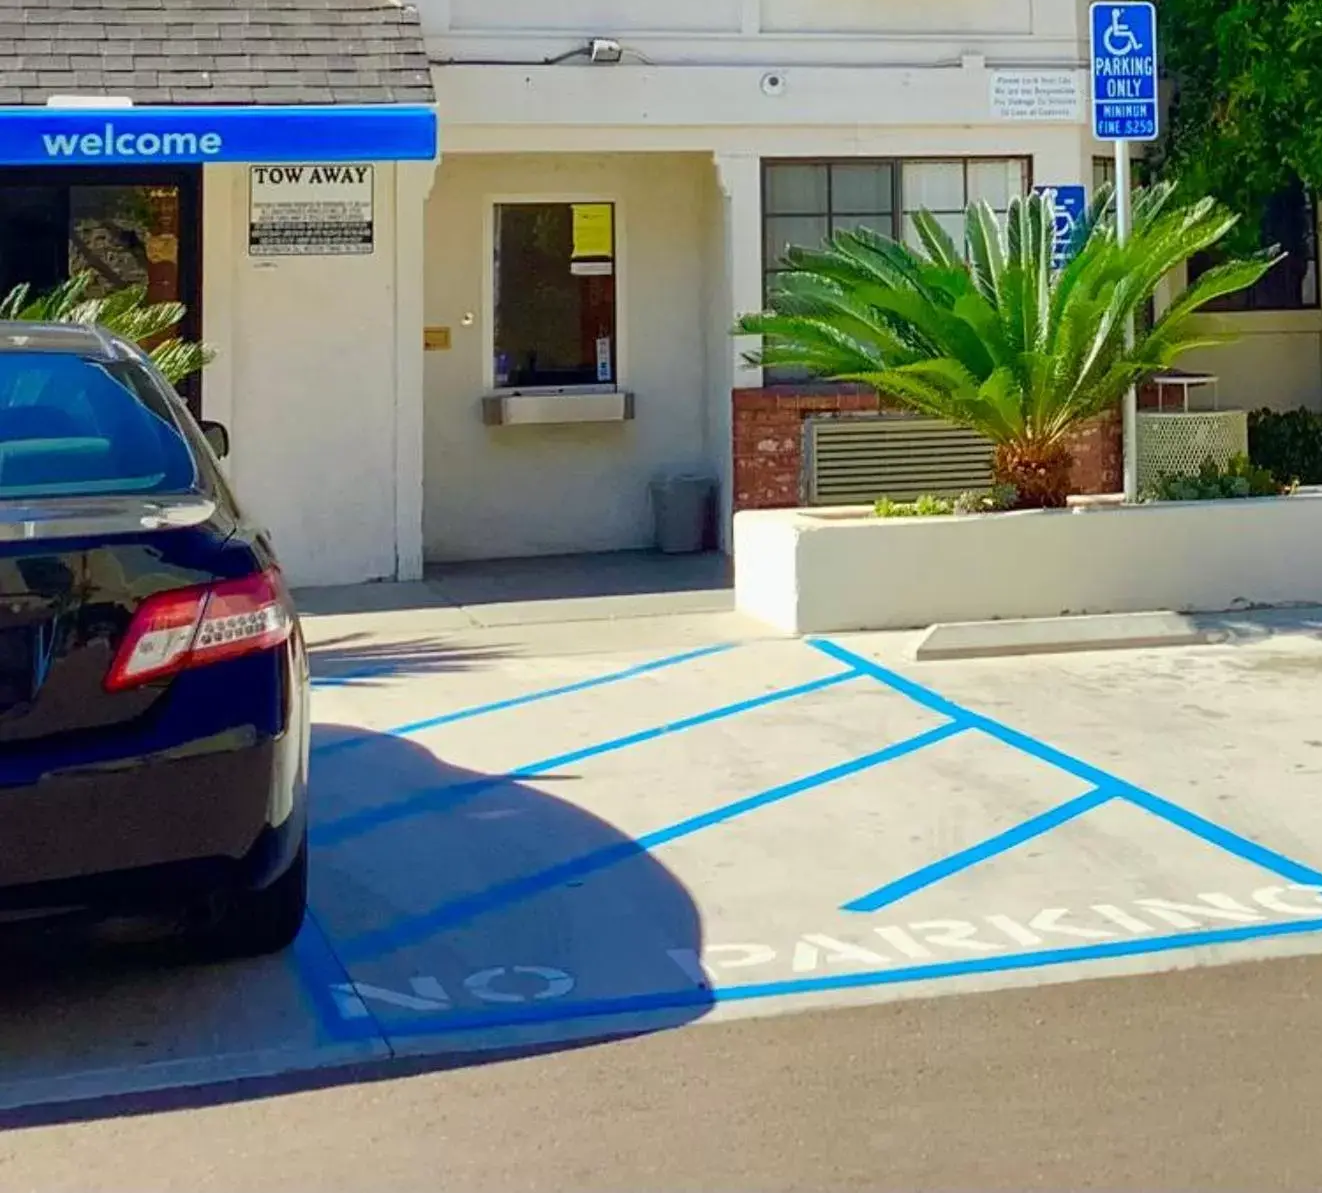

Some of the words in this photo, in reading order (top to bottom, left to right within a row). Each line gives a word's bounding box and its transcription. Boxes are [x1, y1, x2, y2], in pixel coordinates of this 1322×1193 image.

[1096, 56, 1153, 76] PARKING
[1106, 78, 1142, 98] ONLY
[1103, 105, 1147, 118] MINIMUM
[1099, 120, 1121, 134] FINE
[1125, 119, 1154, 135] $250
[42, 122, 222, 156] welcome
[255, 168, 304, 185] TOW
[309, 167, 368, 185] AWAY
[328, 965, 575, 1021] NO
